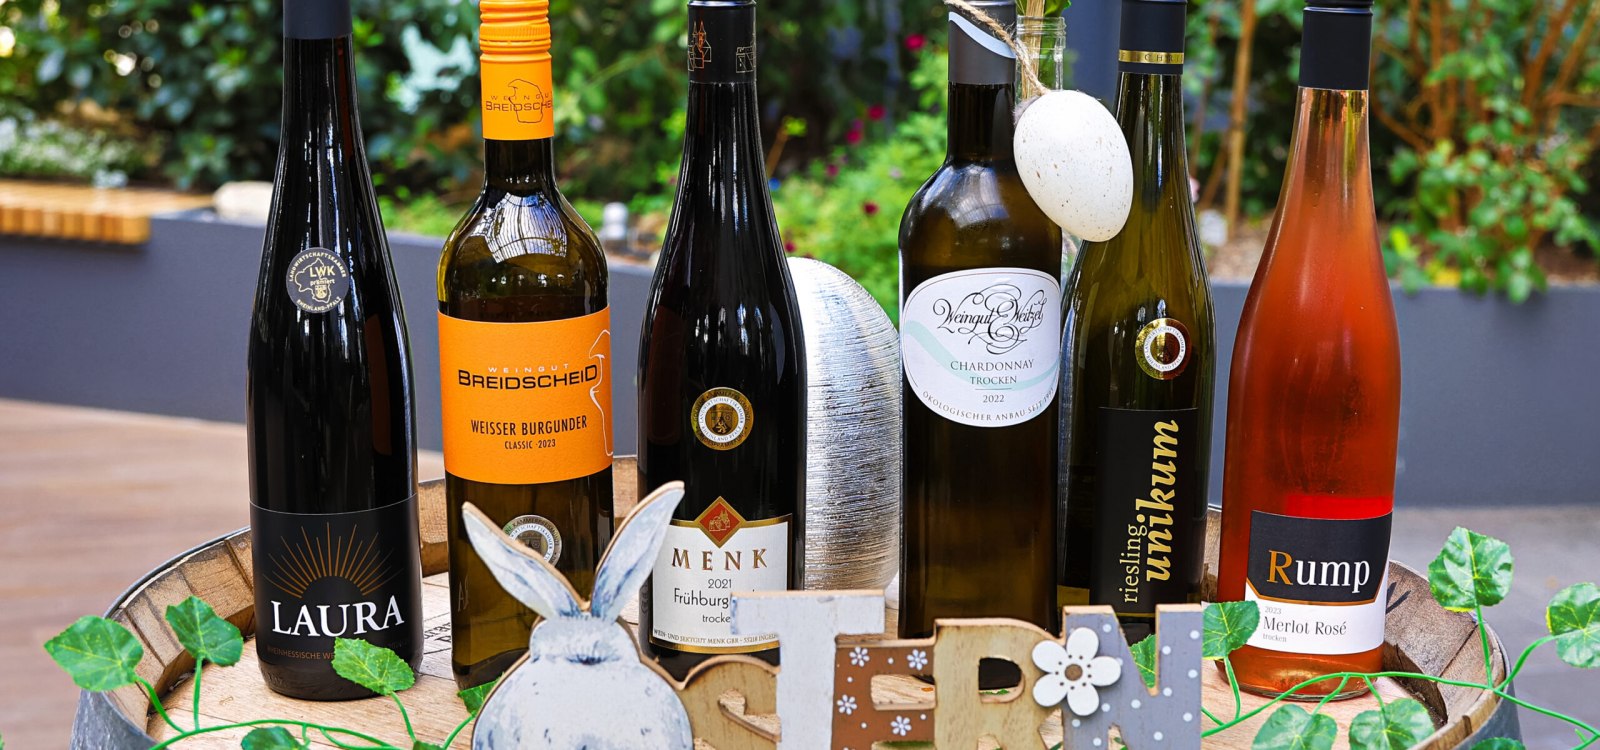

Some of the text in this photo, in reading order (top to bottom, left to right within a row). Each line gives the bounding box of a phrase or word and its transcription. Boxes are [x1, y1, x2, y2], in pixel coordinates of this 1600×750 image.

[490, 91, 552, 101] WEINGU
[485, 100, 552, 112] BREIDSCHE
[310, 265, 336, 277] LWK
[933, 292, 995, 334] Weingut
[488, 363, 569, 373] WEINGUT
[950, 359, 1034, 372] CHARDONNAY
[458, 364, 598, 390] BREIDSCHEID
[970, 375, 1017, 385] TROCKEN
[983, 394, 1005, 403] 2022
[995, 409, 1026, 421] ANBAU
[1027, 400, 1042, 414] SEIT
[471, 415, 588, 436] WEISSER BURGUNDER
[504, 440, 533, 450] CLASSIC
[1136, 419, 1179, 582] unikum
[672, 547, 768, 571] MENK
[1119, 523, 1148, 603] riesling
[1267, 549, 1370, 594] Rump
[708, 578, 732, 589] 2021
[674, 587, 729, 609] Frühburg
[271, 594, 405, 638] LAURA
[1264, 606, 1282, 615] 2023
[702, 612, 731, 624] trocke
[1263, 616, 1347, 636] Merlot Rosé
[667, 632, 679, 641] UND
[707, 637, 726, 645] MENK
[1262, 633, 1287, 643] trocken
